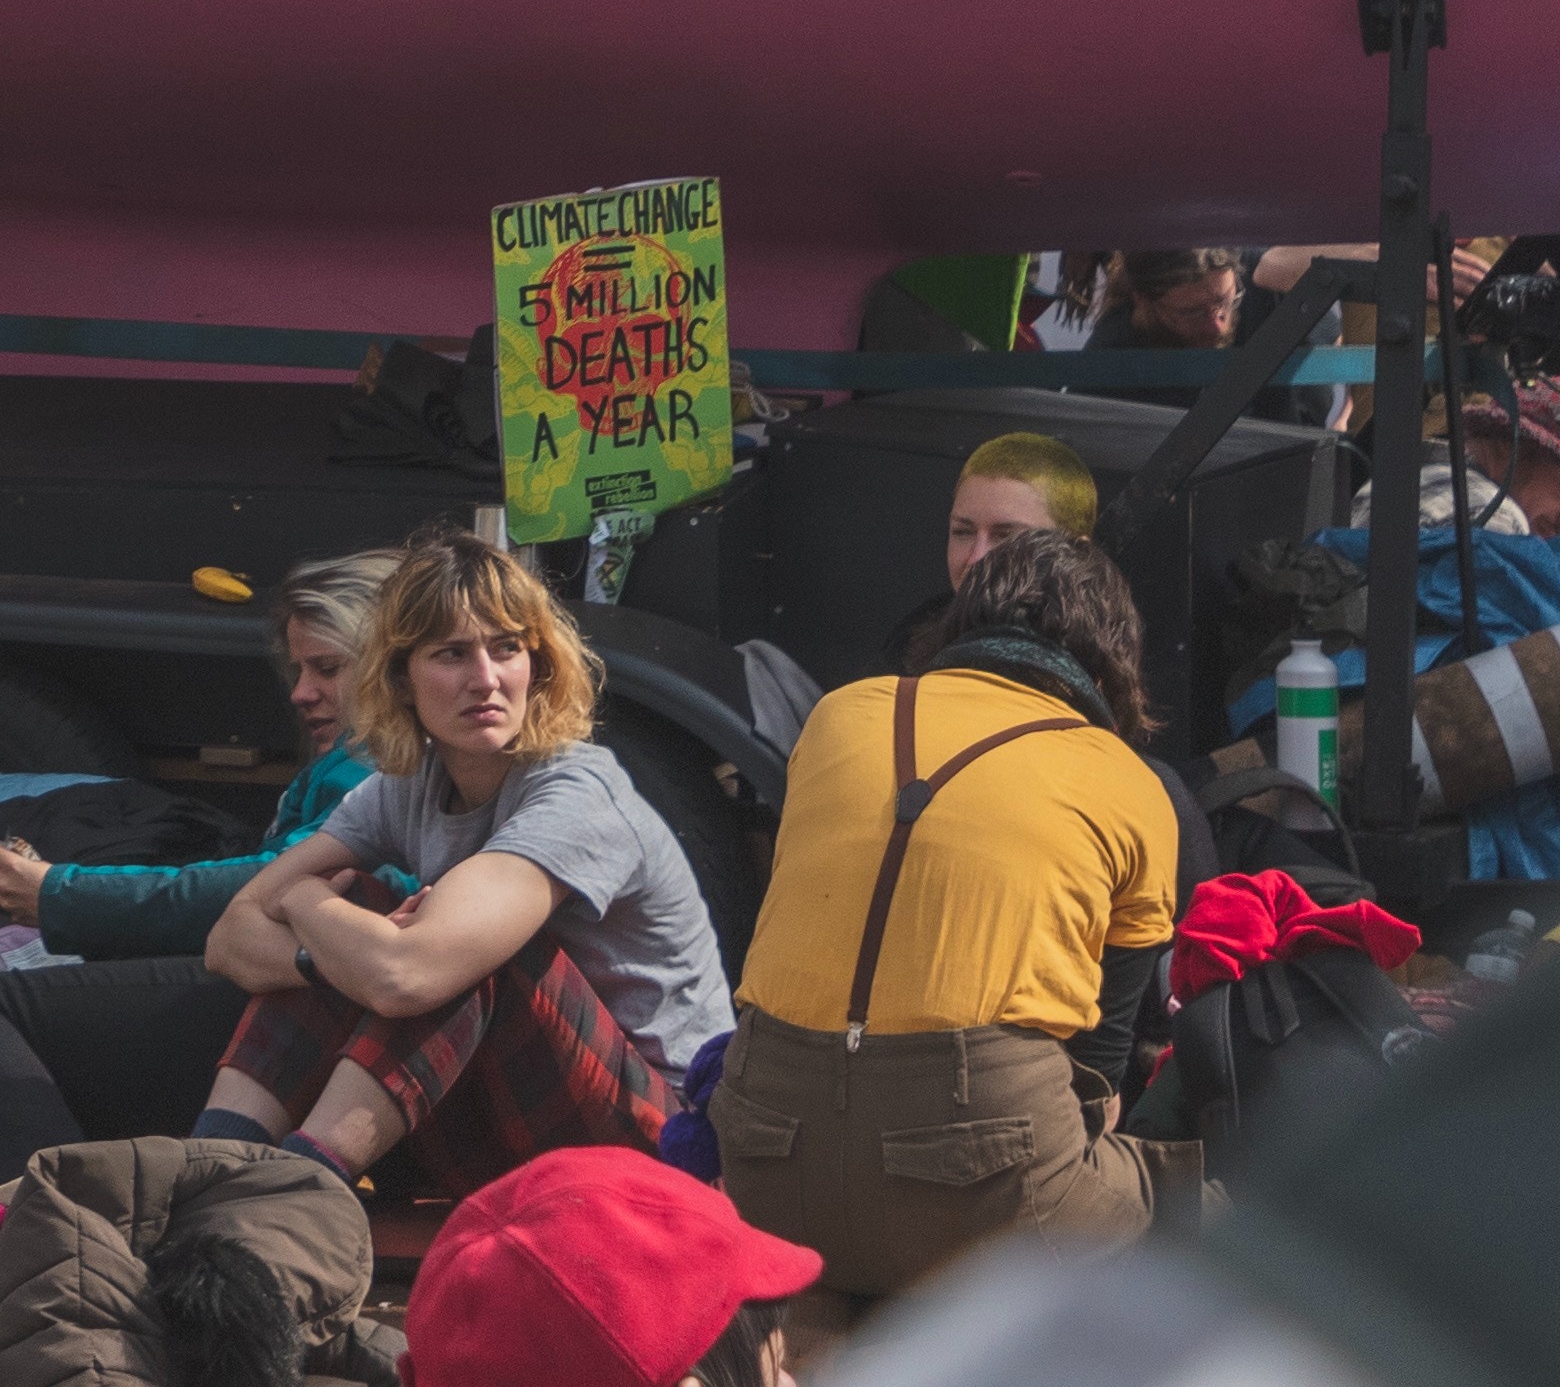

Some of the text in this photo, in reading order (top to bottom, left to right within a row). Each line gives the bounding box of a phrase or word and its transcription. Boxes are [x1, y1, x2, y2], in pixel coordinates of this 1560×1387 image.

[519, 264, 716, 327] 5 MILLION
[544, 316, 709, 390] DEATHS
[532, 389, 700, 463] A YEAR
